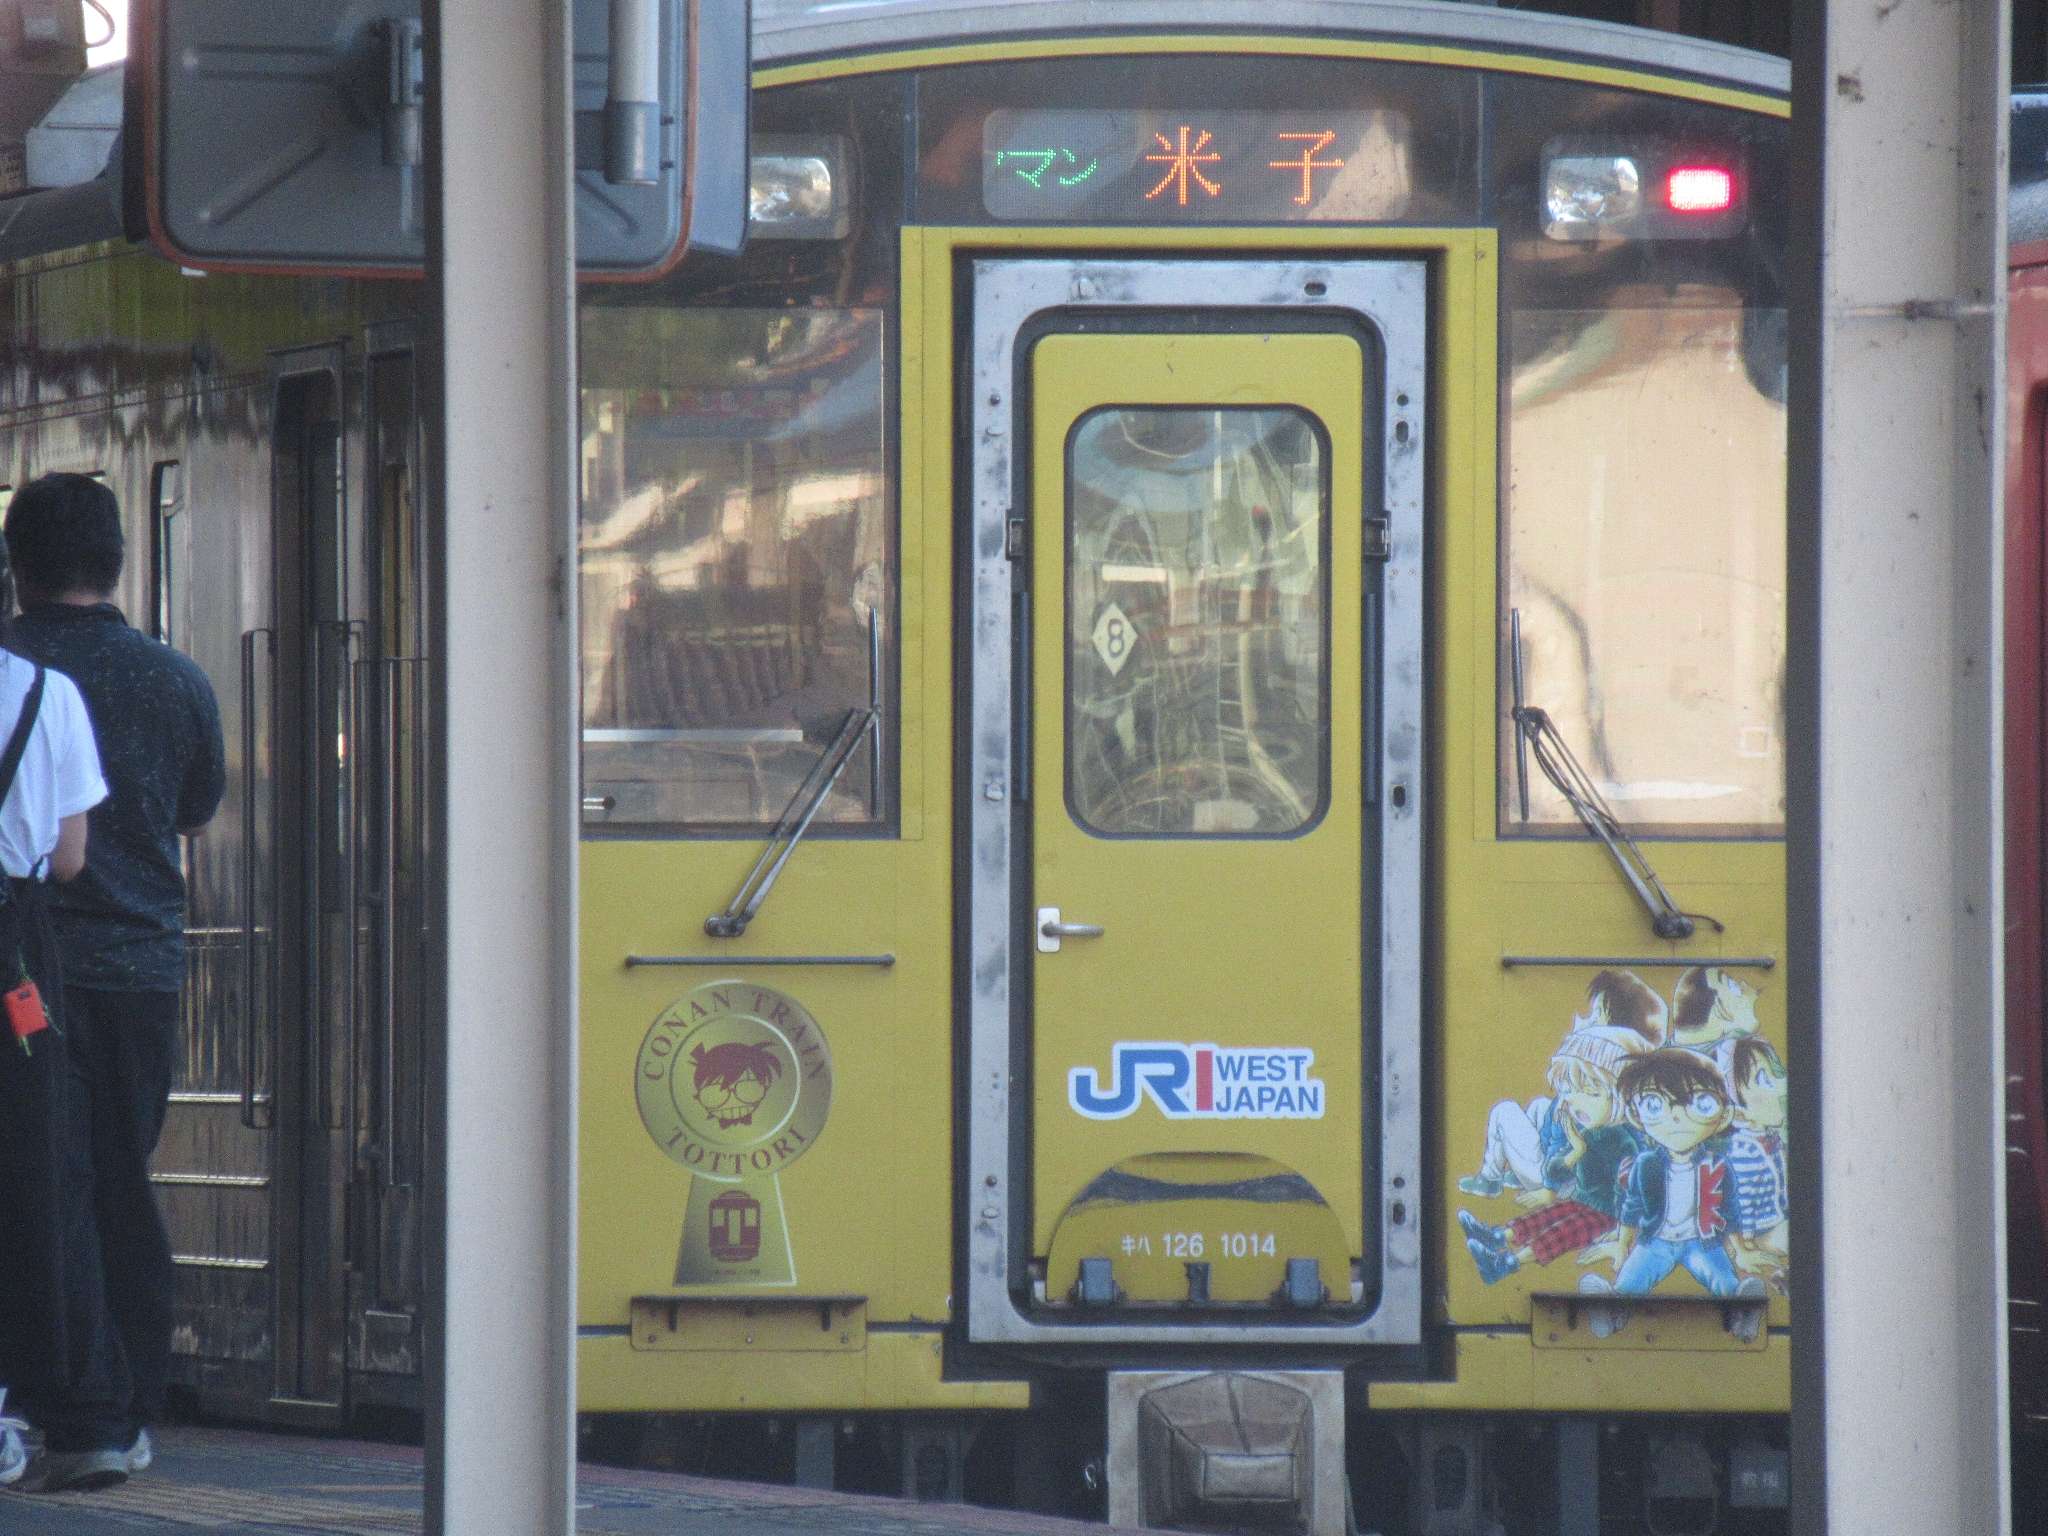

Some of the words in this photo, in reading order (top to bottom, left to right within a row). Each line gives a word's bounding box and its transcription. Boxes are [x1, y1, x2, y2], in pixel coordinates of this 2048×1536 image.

[997, 148, 1097, 188] マン
[1145, 126, 1345, 205] 米子
[1107, 618, 1125, 659] 8
[642, 989, 732, 1081] CONAN
[751, 990, 826, 1080] TRAIN
[1075, 1049, 1191, 1113] JR
[1215, 1055, 1308, 1082] WEST
[1215, 1086, 1319, 1112] JAPAN
[666, 1124, 806, 1175] TOTTORI
[1121, 1233, 1151, 1257] キハ
[1162, 1231, 1205, 1258] 126
[1220, 1231, 1277, 1258] 1014
